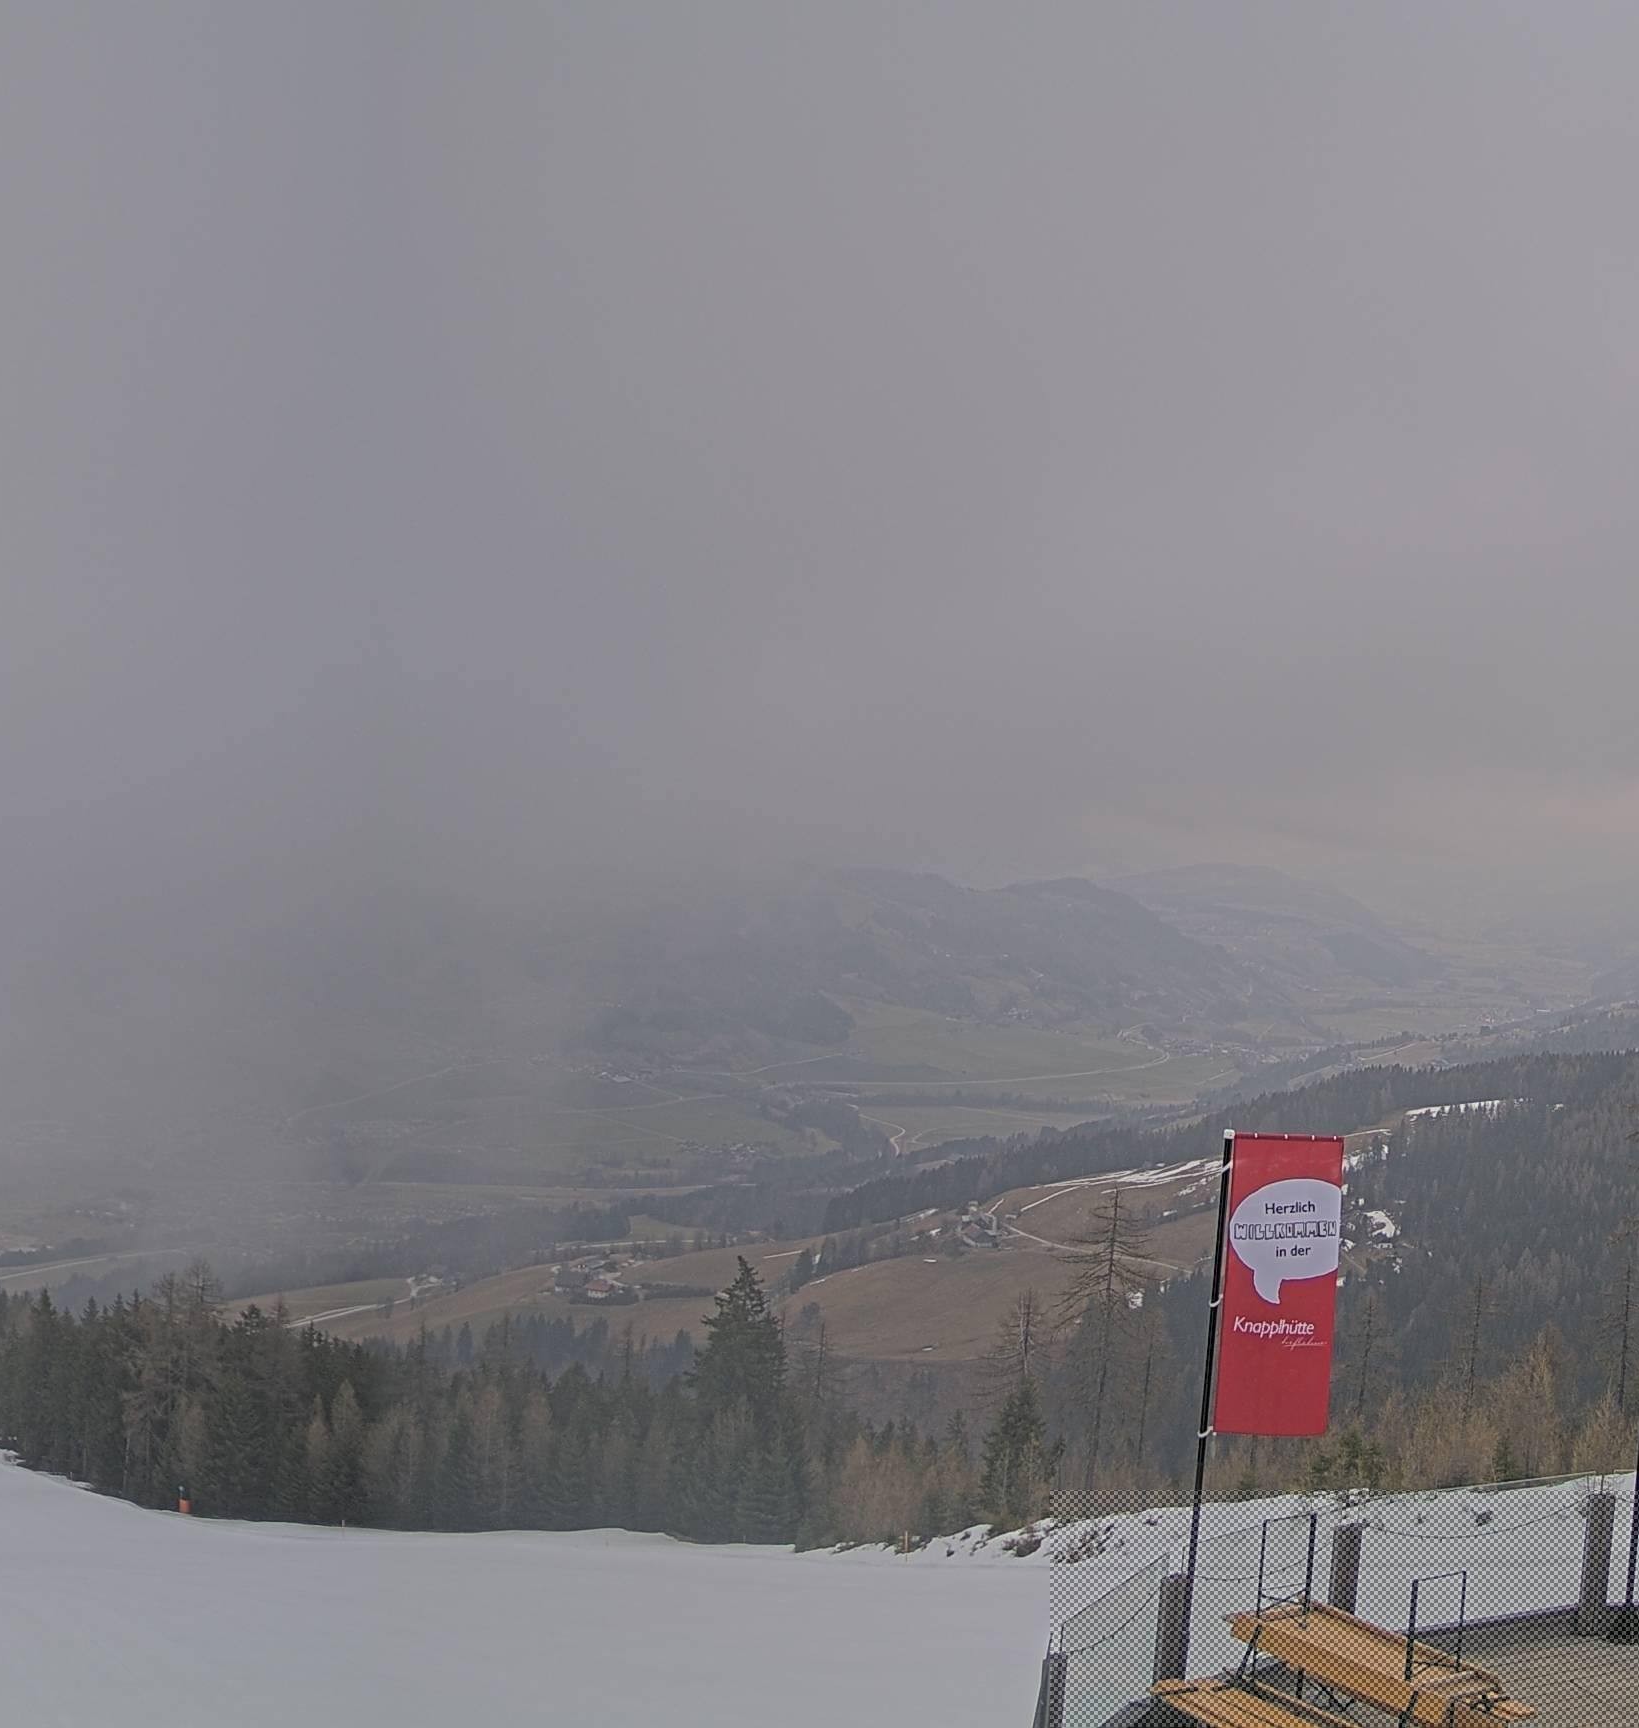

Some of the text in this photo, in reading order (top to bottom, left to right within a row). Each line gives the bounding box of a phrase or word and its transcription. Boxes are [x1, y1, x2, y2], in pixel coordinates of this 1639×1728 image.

[1265, 1201, 1316, 1214] Herzlich
[1234, 1220, 1337, 1240] WILLKOMMEN
[1276, 1245, 1311, 1257] in der
[1233, 1316, 1315, 1339] Knapplhütte
